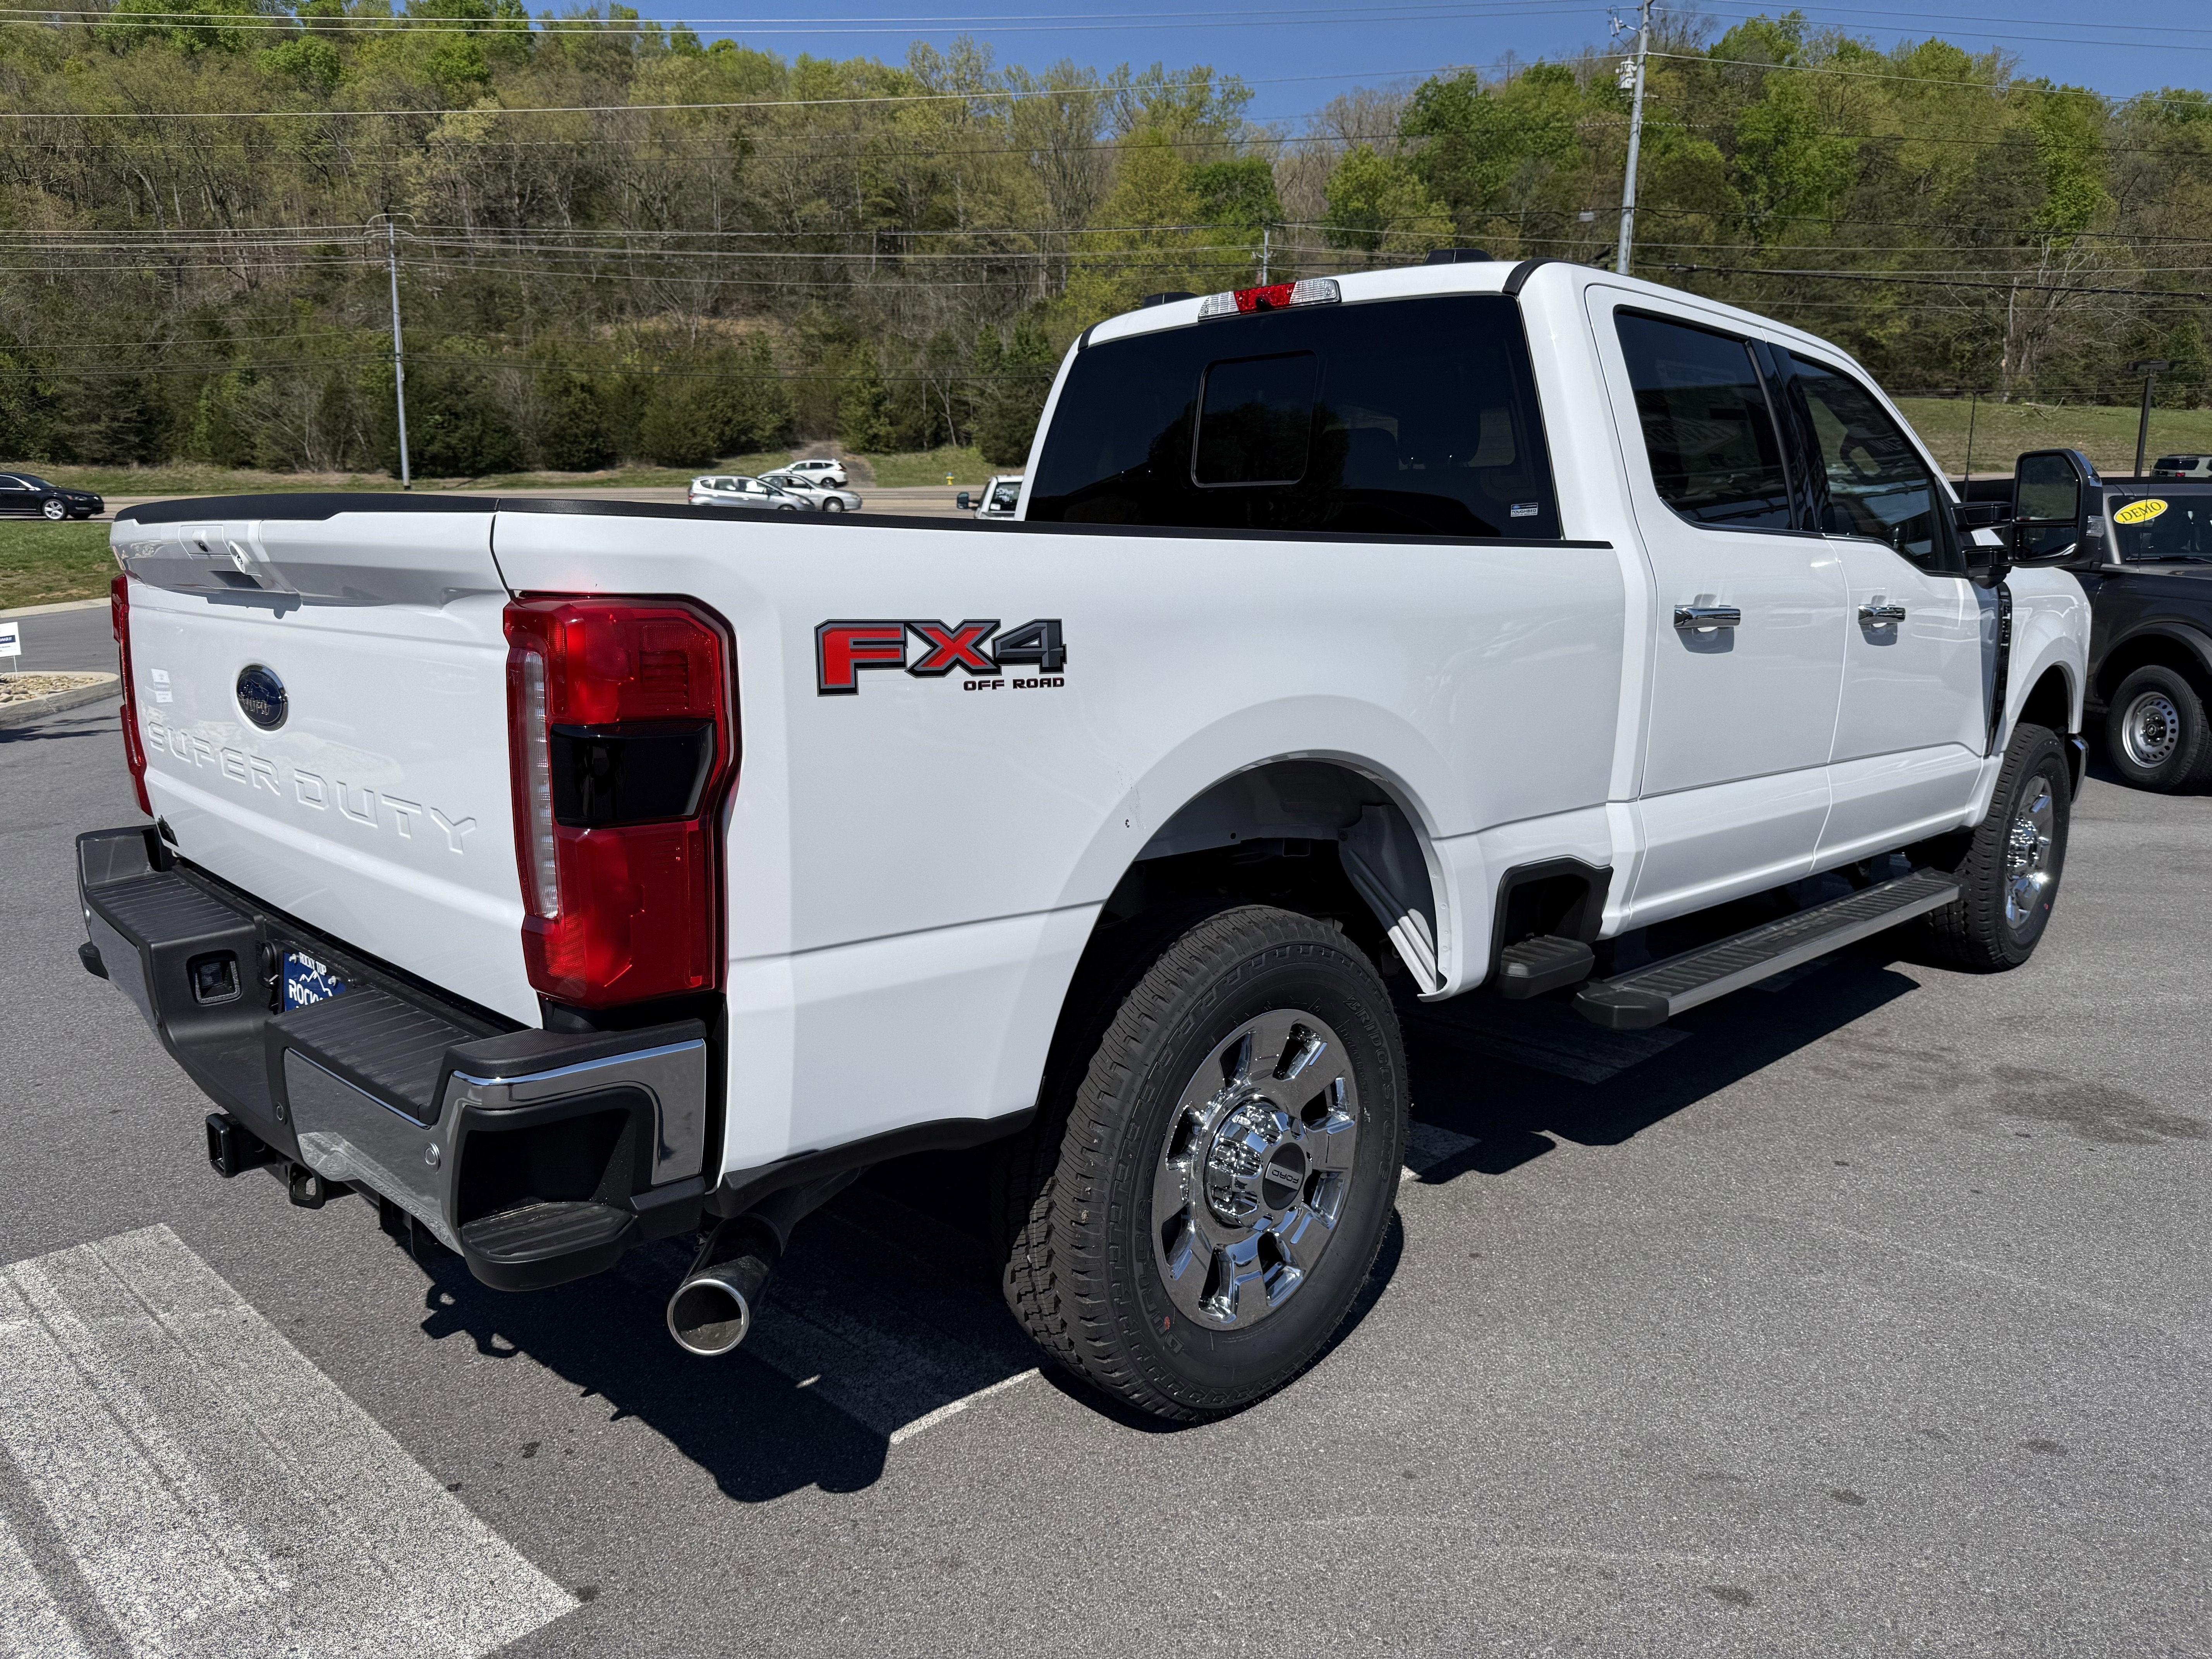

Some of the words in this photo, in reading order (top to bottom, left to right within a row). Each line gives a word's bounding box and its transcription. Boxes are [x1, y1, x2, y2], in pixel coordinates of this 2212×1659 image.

[2119, 502, 2161, 521] DEMO
[814, 619, 1067, 697] FX4
[963, 679, 1005, 691] OFF
[1013, 677, 1065, 689] ROAD
[148, 721, 280, 796] SUPER
[294, 768, 477, 854] DUTY
[299, 952, 315, 970] ROCKY
[315, 961, 326, 975] TOP
[1342, 994, 1395, 1182] BRIDGESTONE
[1272, 1169, 1299, 1184] FORD
